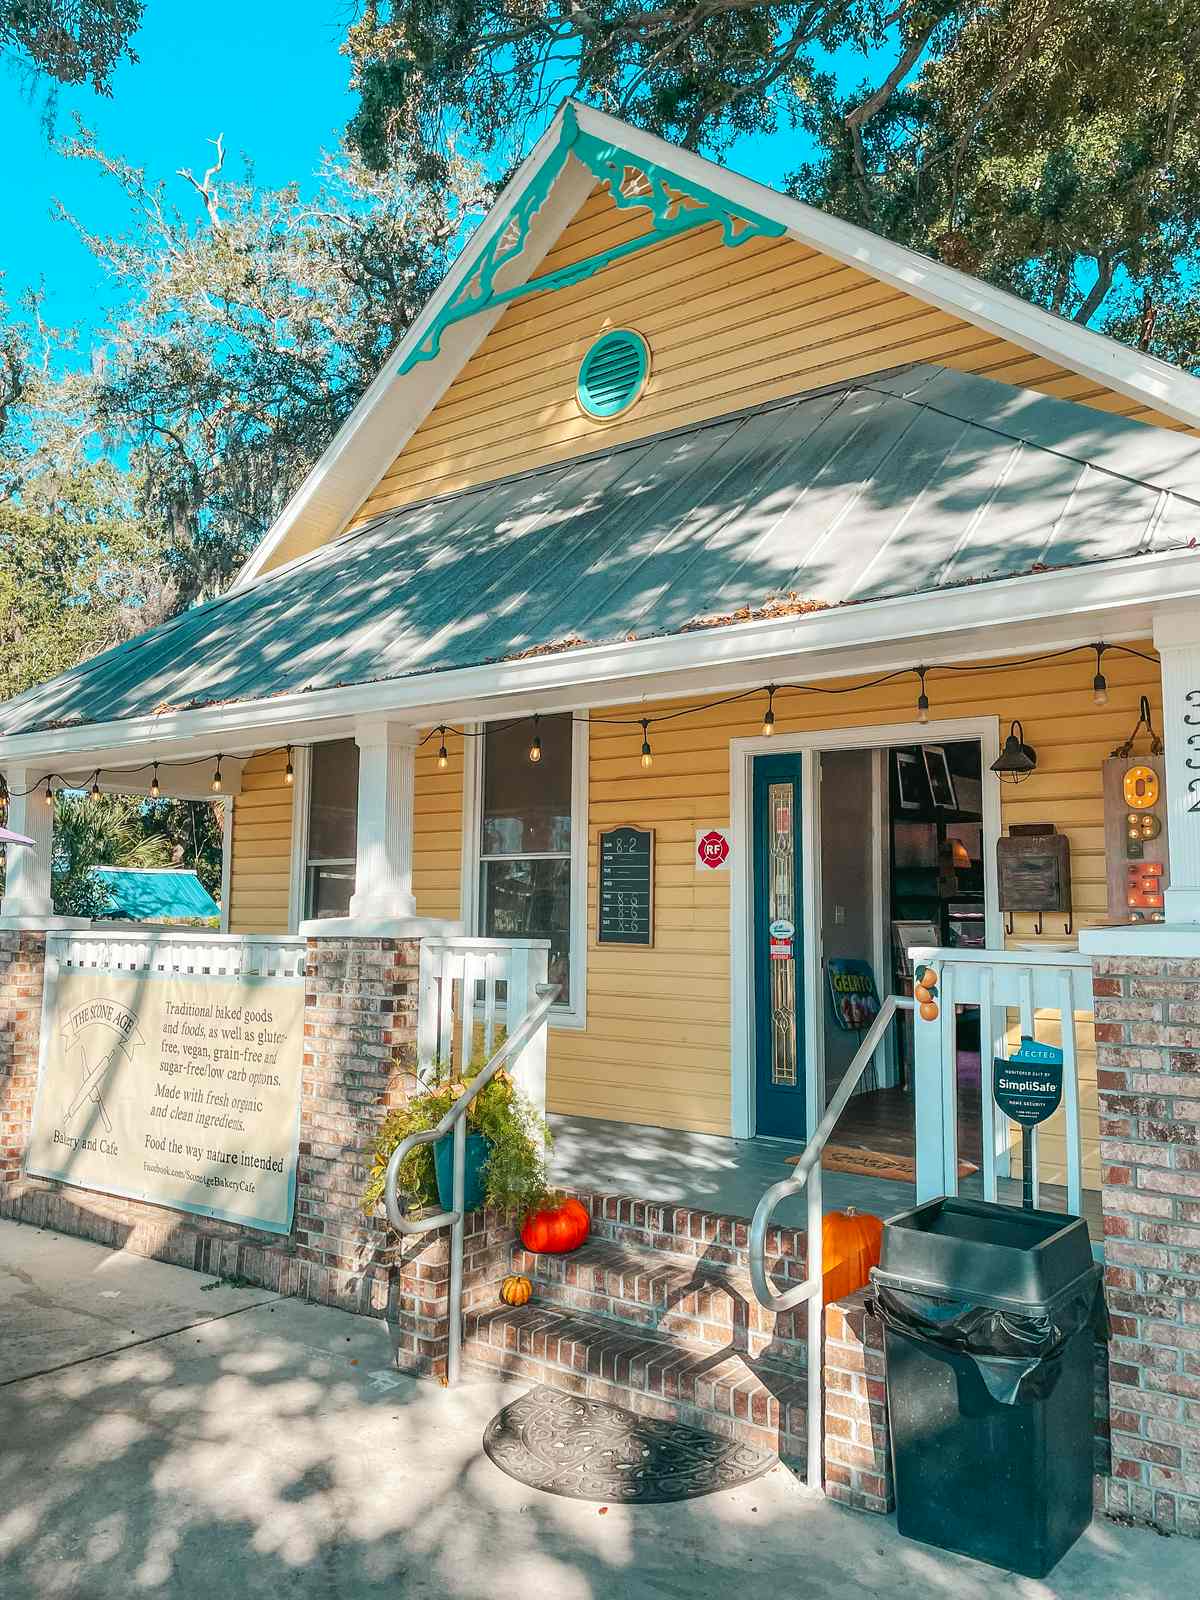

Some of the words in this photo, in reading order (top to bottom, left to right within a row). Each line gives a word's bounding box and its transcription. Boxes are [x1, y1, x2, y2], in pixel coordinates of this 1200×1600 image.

[706, 844, 721, 855] RF
[1123, 766, 1164, 923] OPE
[833, 975, 873, 992] GELATO
[72, 1007, 90, 1028] THE
[113, 1012, 134, 1034] AGE
[166, 1001, 213, 1018] Traditional
[215, 1006, 242, 1020] baked
[244, 1009, 273, 1024] goods
[163, 1021, 178, 1034] and
[181, 1022, 206, 1038] foods,
[208, 1028, 218, 1038] as
[221, 1026, 242, 1040] well
[244, 1030, 254, 1042] as
[161, 1040, 180, 1054] free,
[182, 1044, 210, 1060] vegan,
[214, 1046, 262, 1063] grain-free
[227, 1068, 246, 1082] carb
[998, 1078, 1056, 1092] SimpliSafe
[154, 1082, 180, 1099] Made
[184, 1088, 204, 1104] with
[206, 1090, 230, 1108] fresh
[150, 1104, 168, 1118] and
[170, 1106, 194, 1122] clean
[82, 1138, 97, 1152] and
[100, 1140, 118, 1156] Cafe
[144, 1134, 166, 1152] Food
[168, 1138, 182, 1154] the
[186, 1146, 203, 1162] way
[206, 1149, 238, 1164] nature
[240, 1151, 284, 1173] intended
